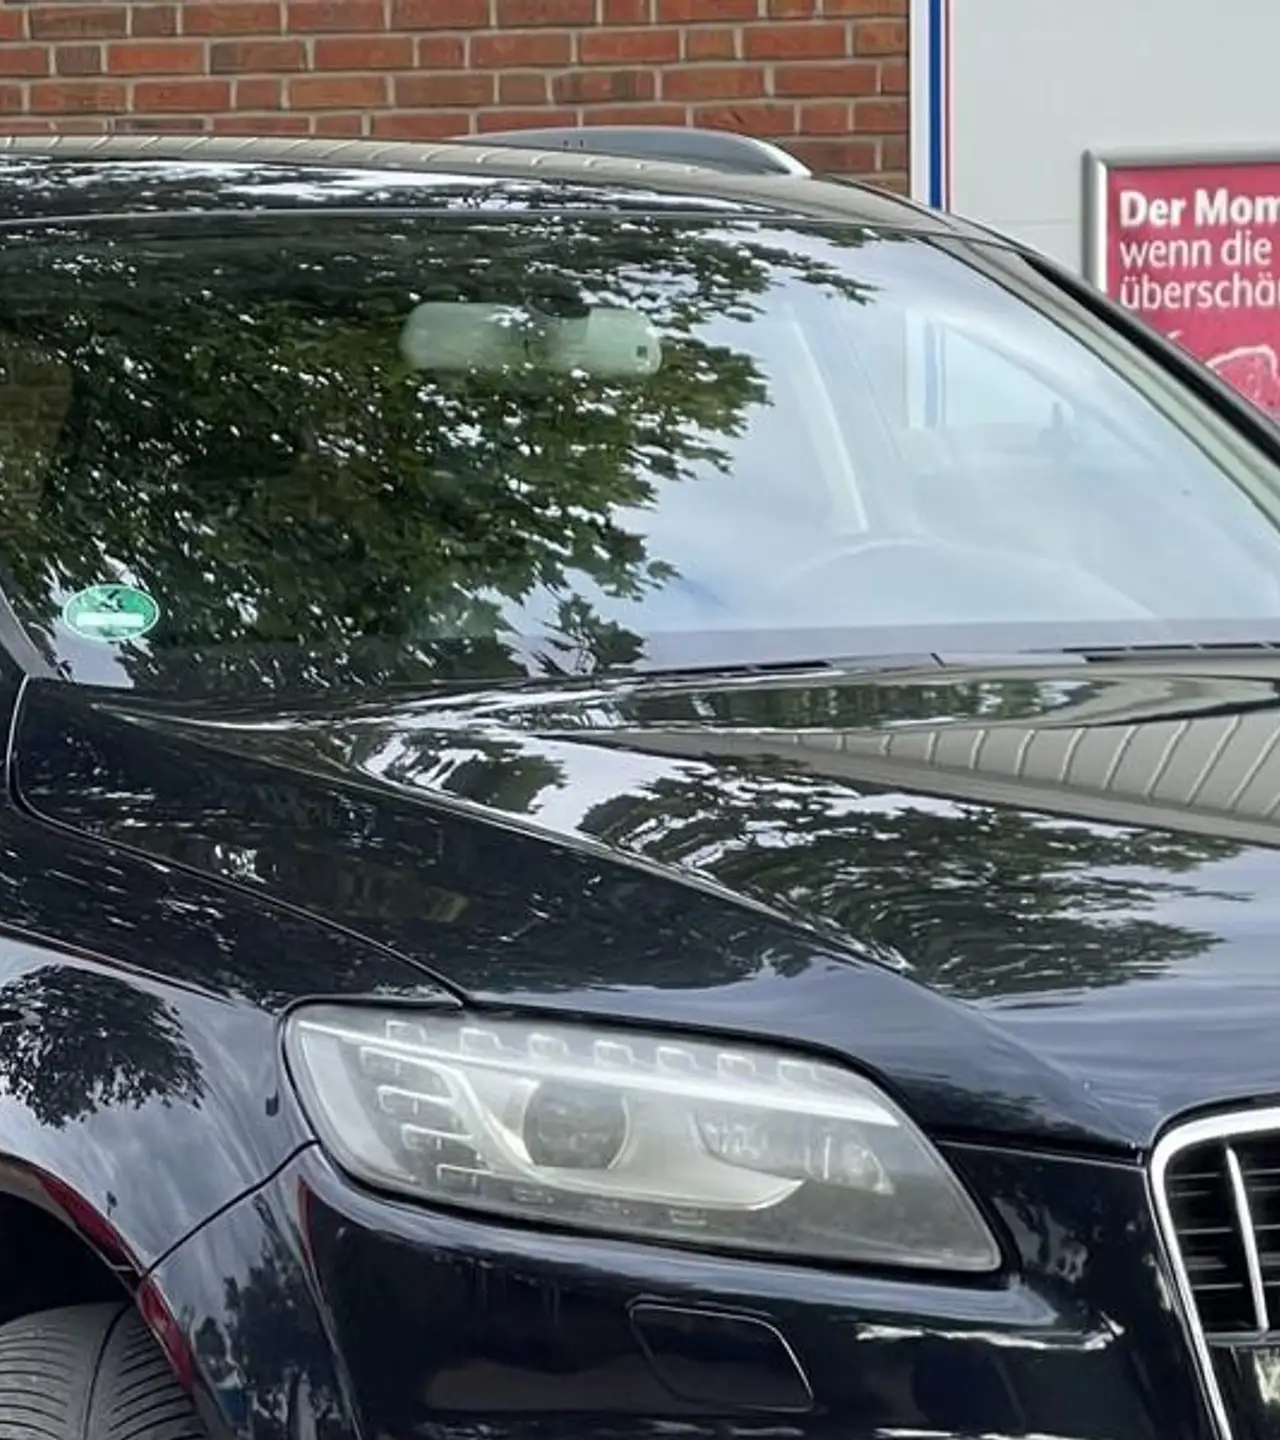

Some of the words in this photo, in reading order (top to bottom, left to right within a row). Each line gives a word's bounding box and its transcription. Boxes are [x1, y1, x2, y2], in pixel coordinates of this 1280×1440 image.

[1120, 189, 1187, 228] Der
[1120, 238, 1213, 269] wenn
[1221, 230, 1273, 266] die
